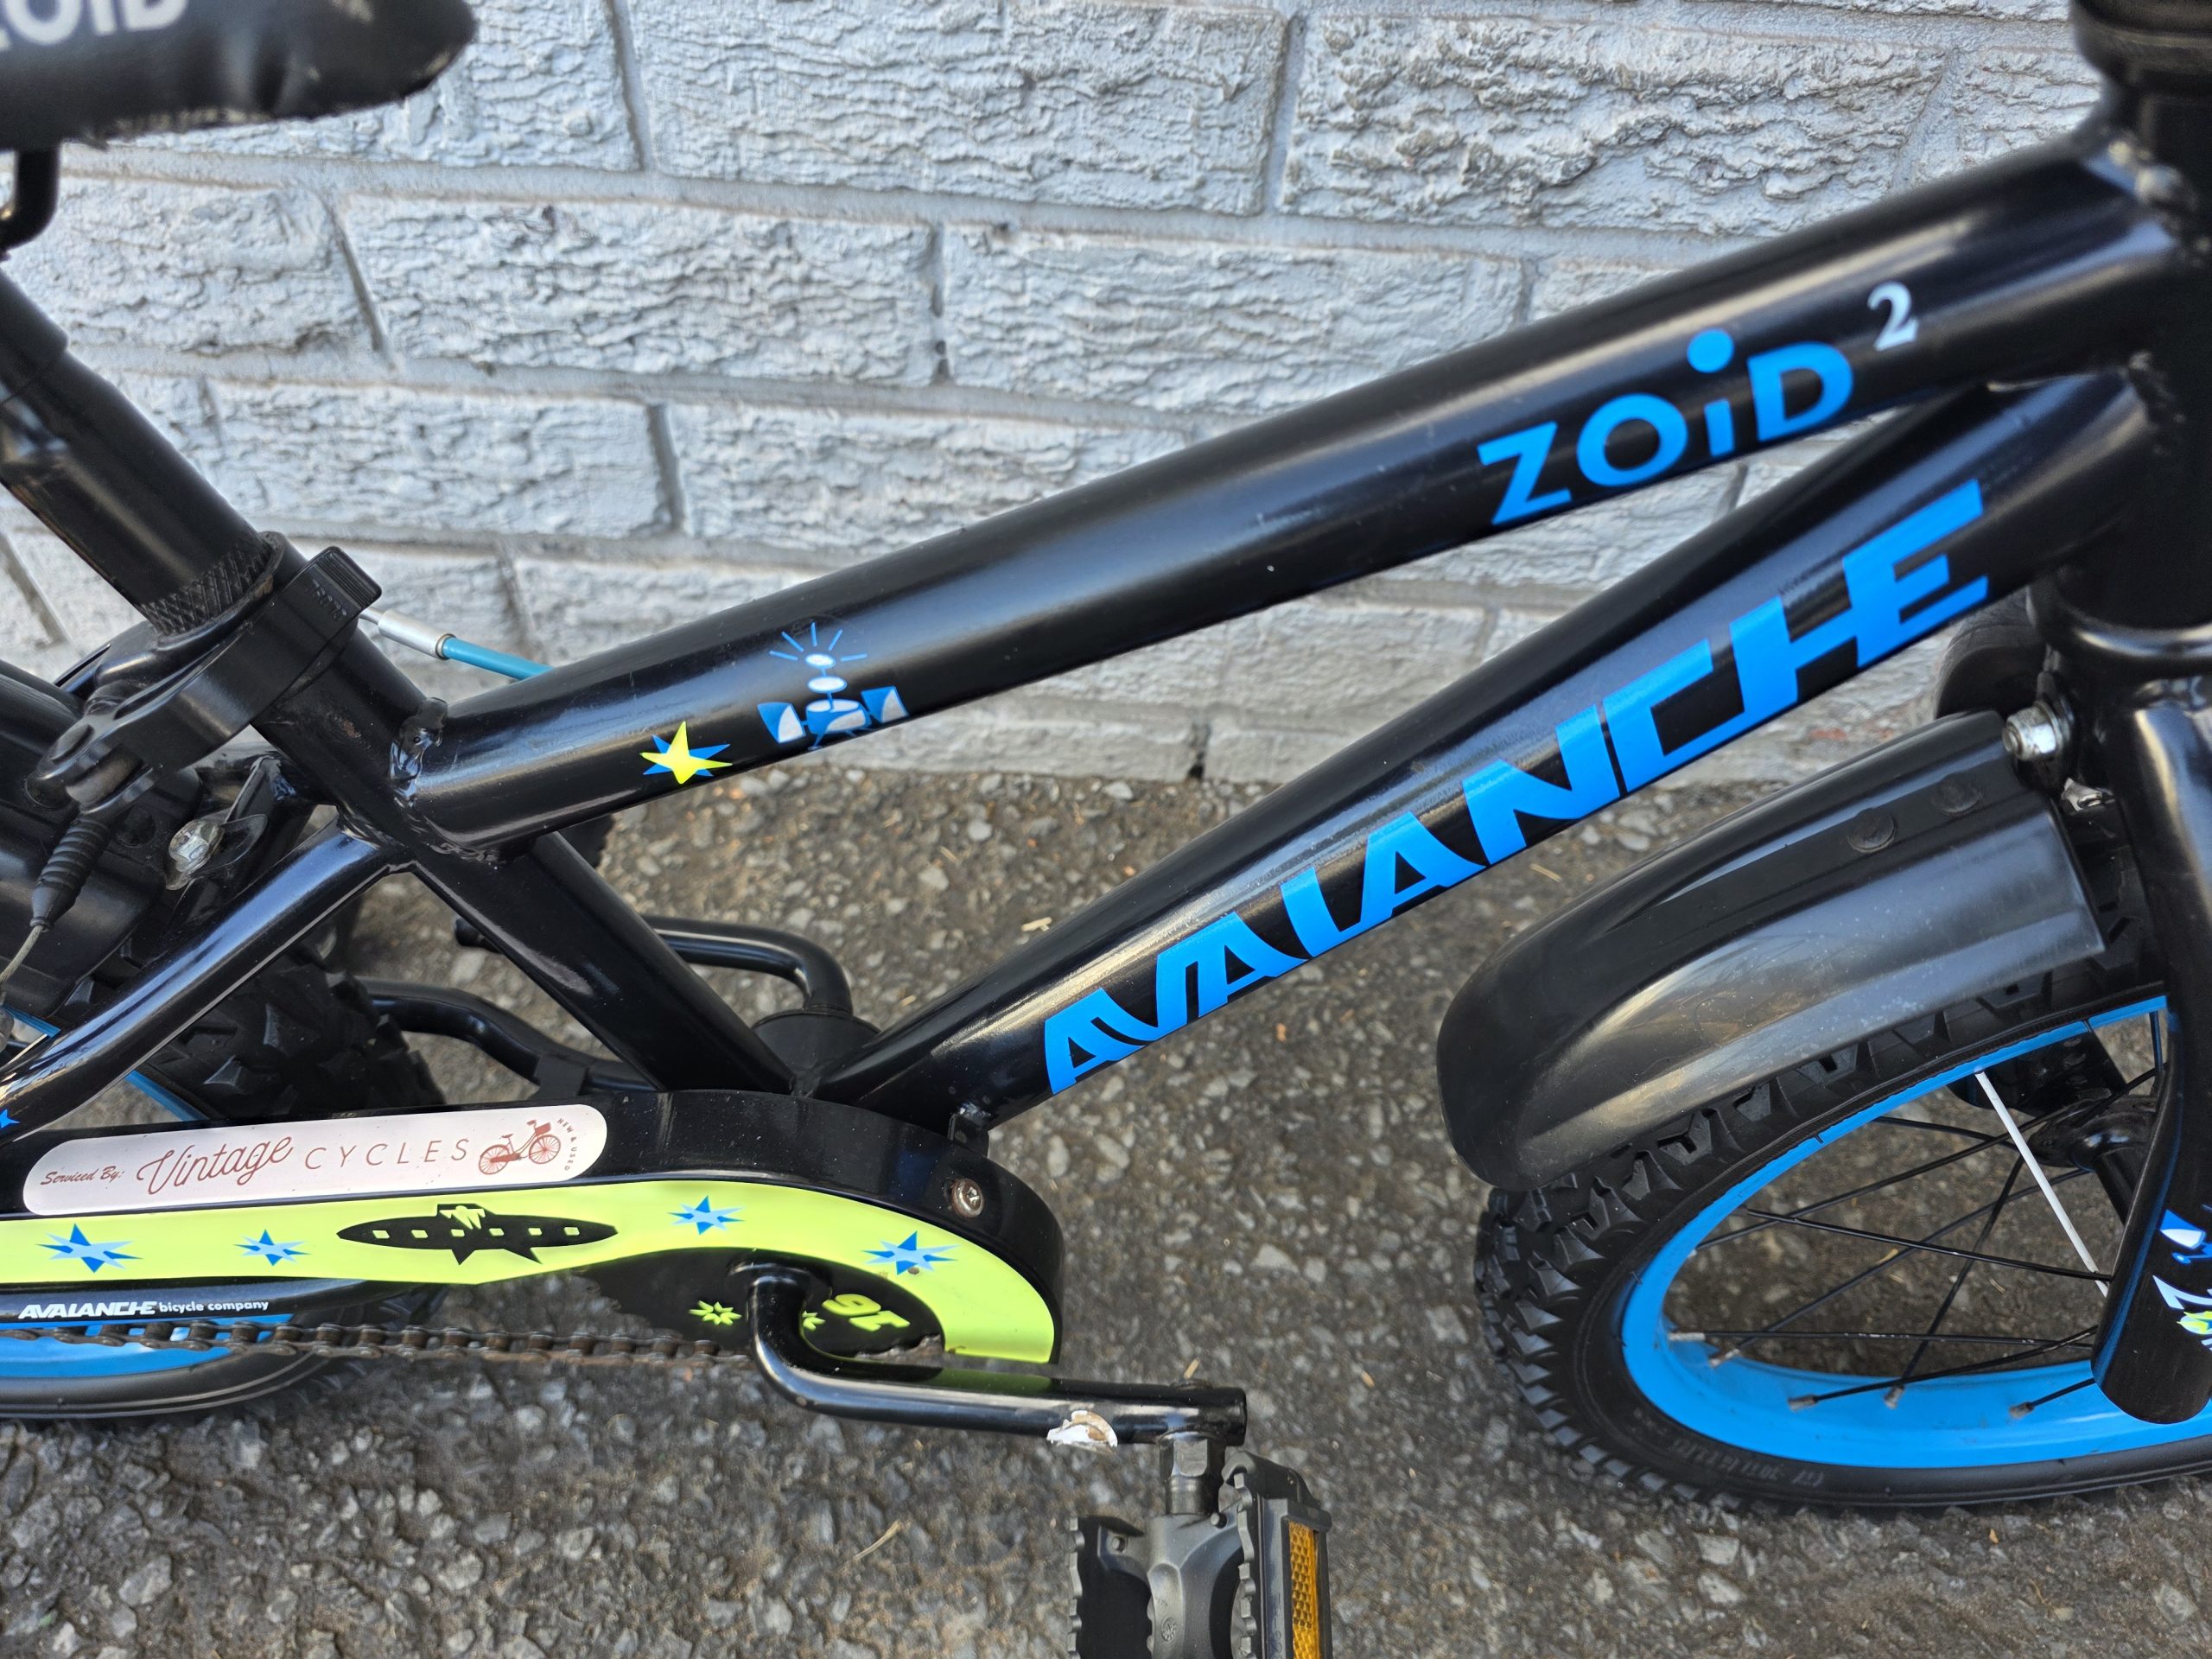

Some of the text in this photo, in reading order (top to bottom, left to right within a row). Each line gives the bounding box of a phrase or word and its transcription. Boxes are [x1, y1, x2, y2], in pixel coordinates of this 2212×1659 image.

[1867, 282, 1919, 351] 2
[1045, 480, 1988, 1094] AVALANCHE
[556, 1118, 574, 1133] NEW
[137, 1136, 469, 1195] Vintage CYCLES
[564, 1147, 577, 1171] USED
[40, 1166, 125, 1185] Serviced By:
[18, 1300, 269, 1319] AVALANCHE bicycle company
[822, 1294, 910, 1332] 16
